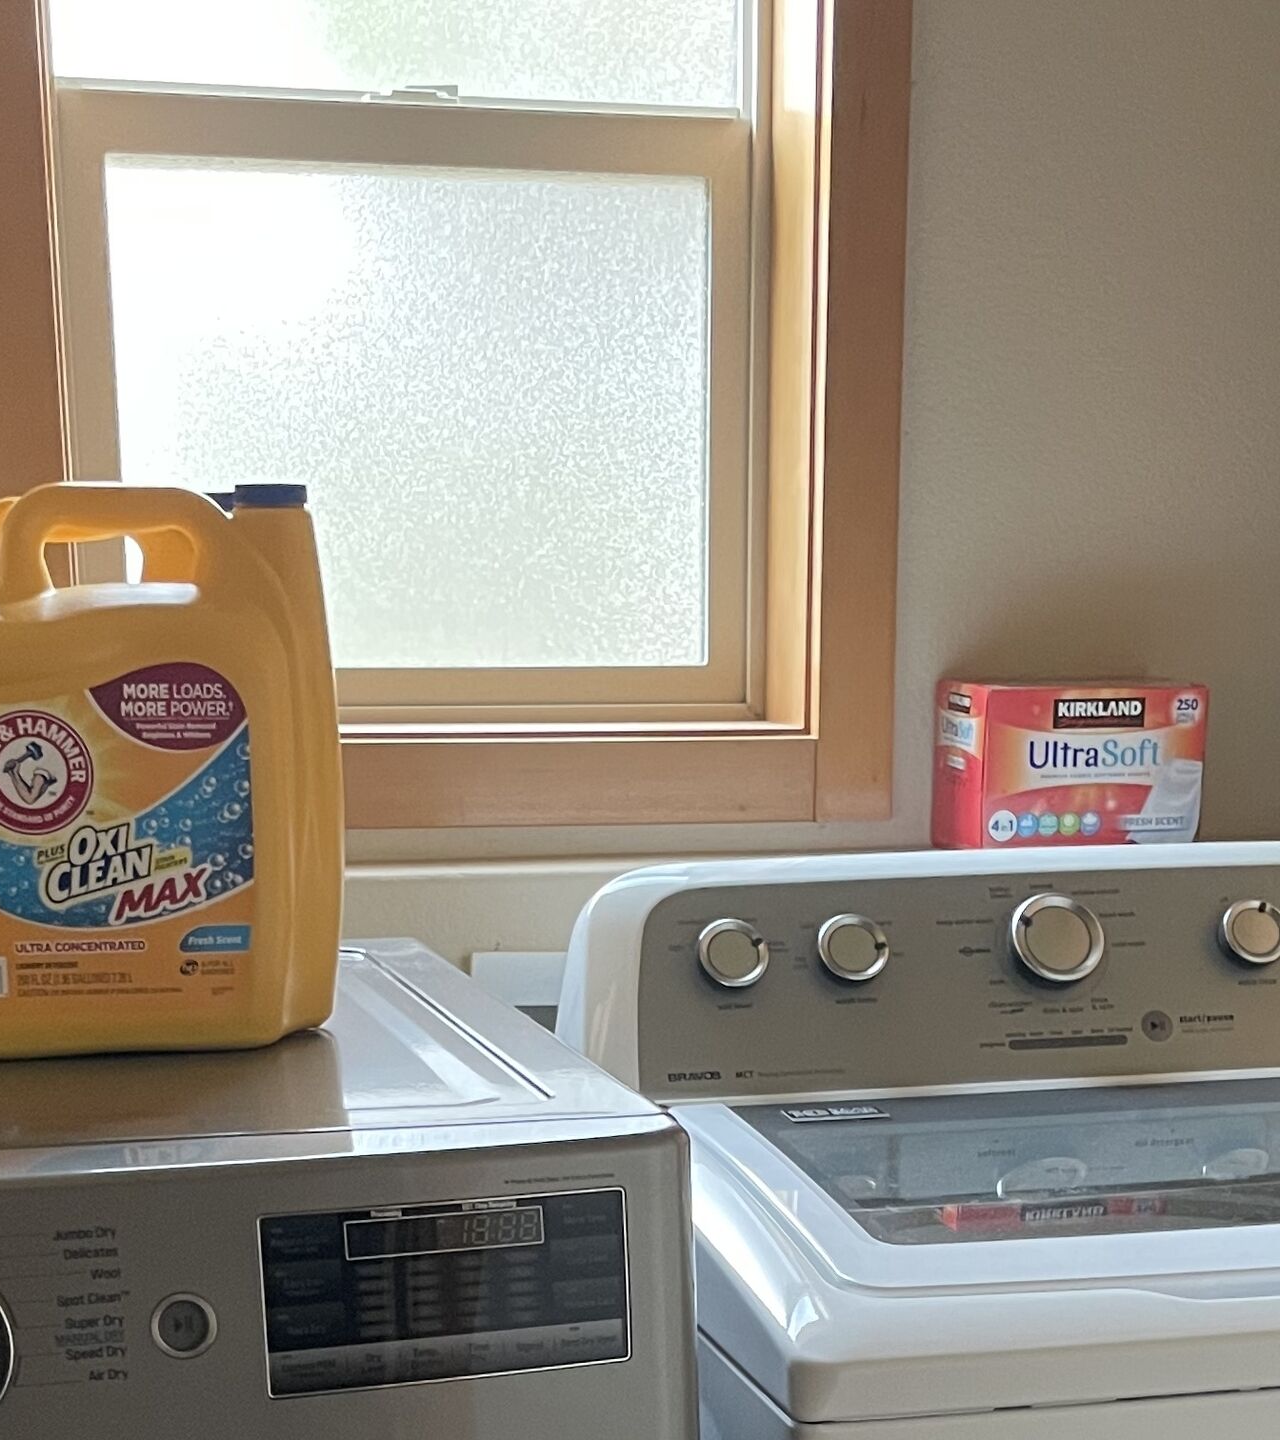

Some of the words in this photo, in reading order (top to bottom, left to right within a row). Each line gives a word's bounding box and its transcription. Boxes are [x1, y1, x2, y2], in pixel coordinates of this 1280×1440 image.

[122, 683, 169, 699] MORE
[173, 683, 227, 699] LOADS.
[120, 702, 167, 717] MORE
[1058, 701, 1143, 717] KIRKLAND
[1177, 698, 1199, 711] 250
[16, 717, 87, 784] HAMMER
[1029, 738, 1160, 769] UltraSoft
[991, 820, 1000, 832] 4
[1008, 820, 1014, 832] 1
[1123, 817, 1153, 827] FRESH
[1155, 816, 1184, 826] SCENT
[37, 844, 65, 858] PLUS
[70, 826, 129, 866] OXI
[47, 847, 152, 902] CLEAN
[114, 867, 208, 921] MAX
[15, 942, 52, 953] ULTRA
[55, 940, 146, 953] CONCENTRATED
[188, 935, 214, 945] Fresh
[216, 935, 242, 945] Scent
[95, 1226, 116, 1240] Dry
[63, 1248, 119, 1260] Delicates
[90, 1268, 121, 1280] Wool
[56, 1295, 85, 1307] Spot
[65, 1317, 101, 1330] Super
[103, 1315, 125, 1328] Dry
[65, 1349, 104, 1362] Speed
[106, 1346, 128, 1359] Dry
[88, 1370, 106, 1381] Air
[108, 1368, 128, 1381] Dry
